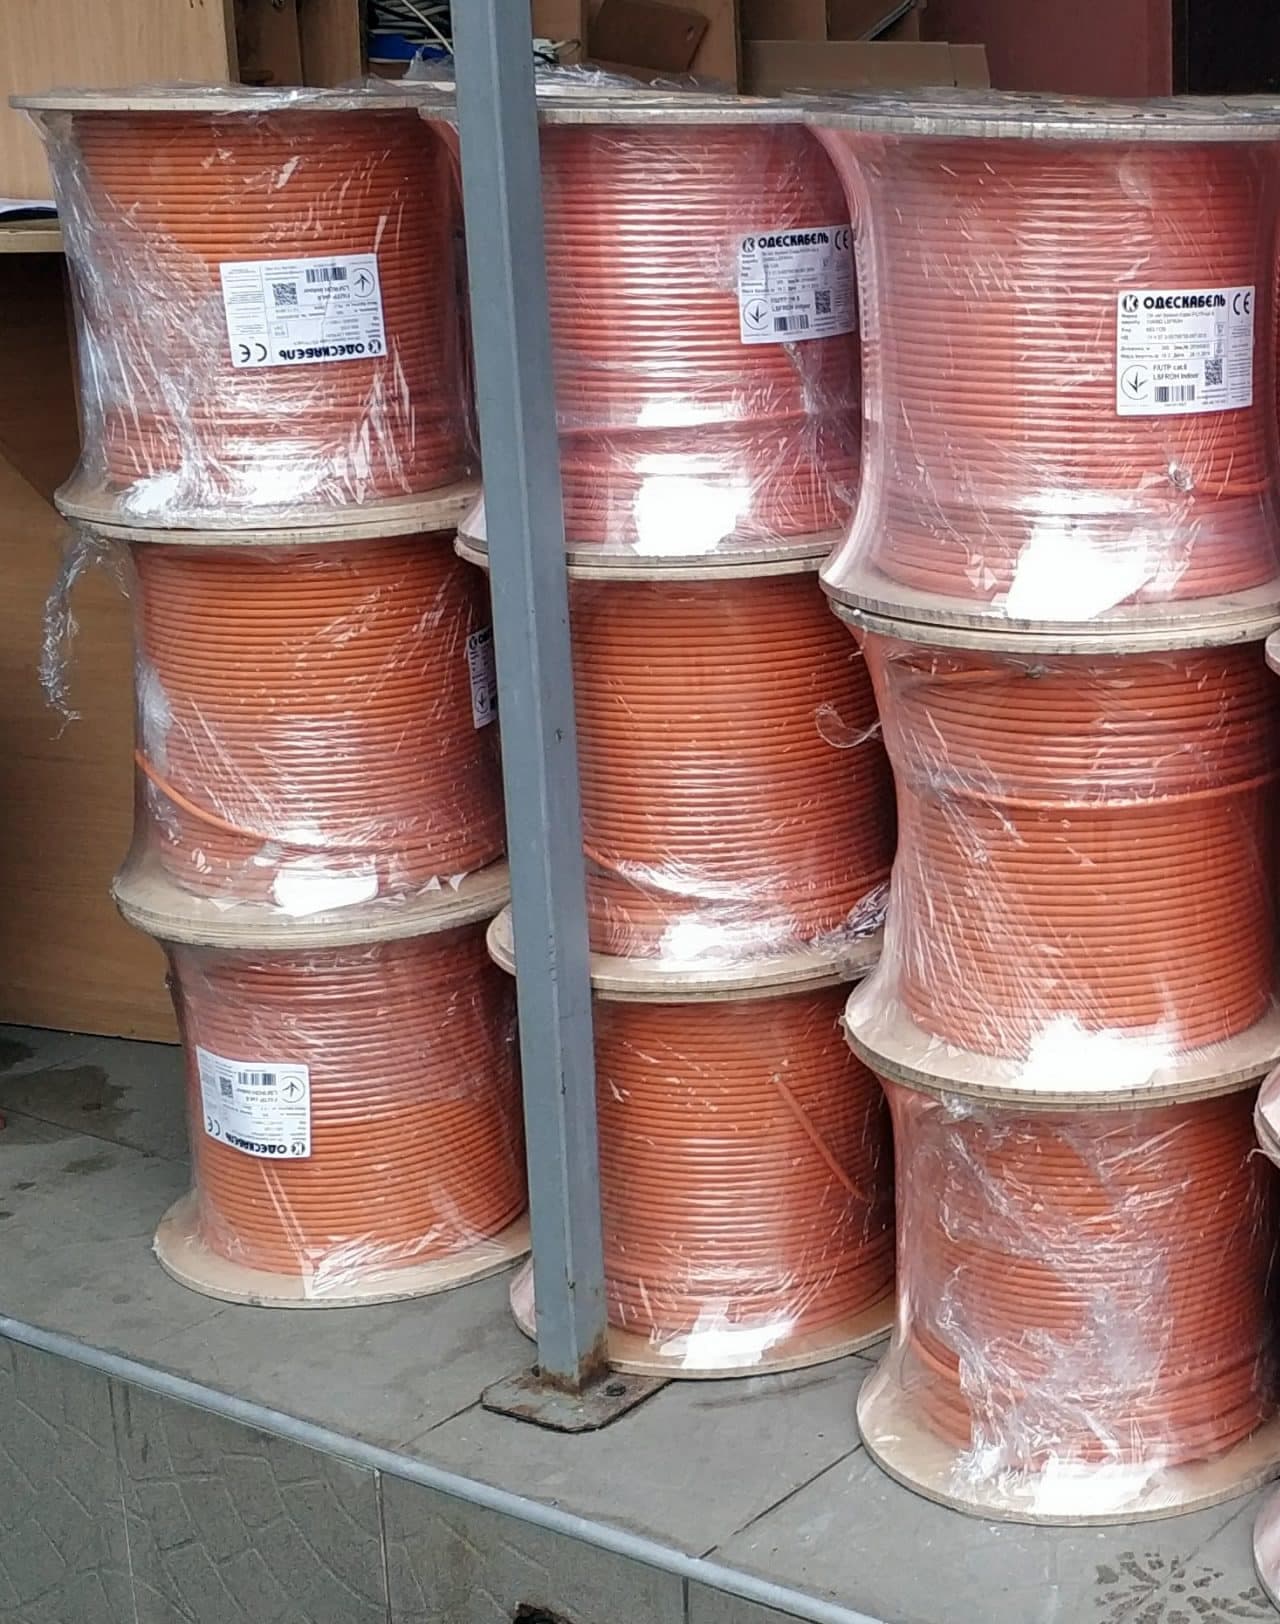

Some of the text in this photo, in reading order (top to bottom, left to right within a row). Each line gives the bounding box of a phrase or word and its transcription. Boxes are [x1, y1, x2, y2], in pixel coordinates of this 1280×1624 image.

[758, 232, 829, 249] ОДЕСКАБЕЛЬ
[834, 230, 849, 251] CE
[1143, 294, 1226, 310] ОДЕСКАБЕЛЬ
[1232, 291, 1251, 316] CE
[238, 343, 267, 363] CE
[278, 342, 365, 361] ОДЕСКАБЕЛЬ
[206, 1115, 221, 1137] CE
[225, 1132, 287, 1154] ОДЕСКАБЕЛЬ
